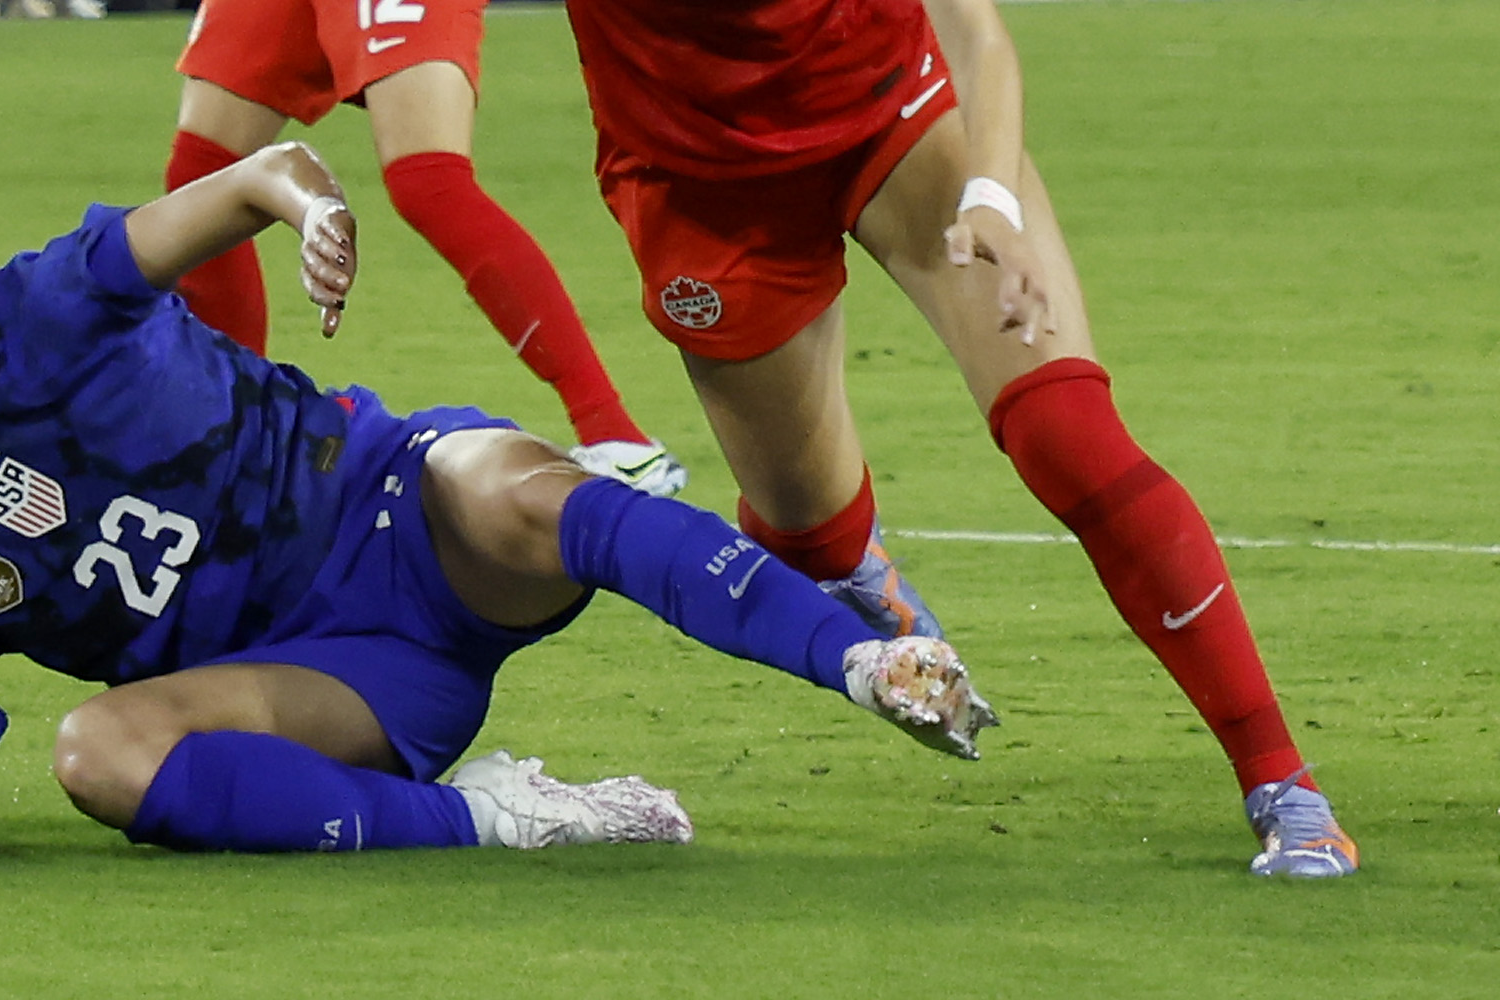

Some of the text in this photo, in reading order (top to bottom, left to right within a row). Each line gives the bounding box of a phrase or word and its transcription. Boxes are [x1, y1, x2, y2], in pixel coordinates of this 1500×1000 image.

[665, 296, 716, 312] CANADA
[72, 494, 201, 619] 23
[704, 537, 755, 576] USA
